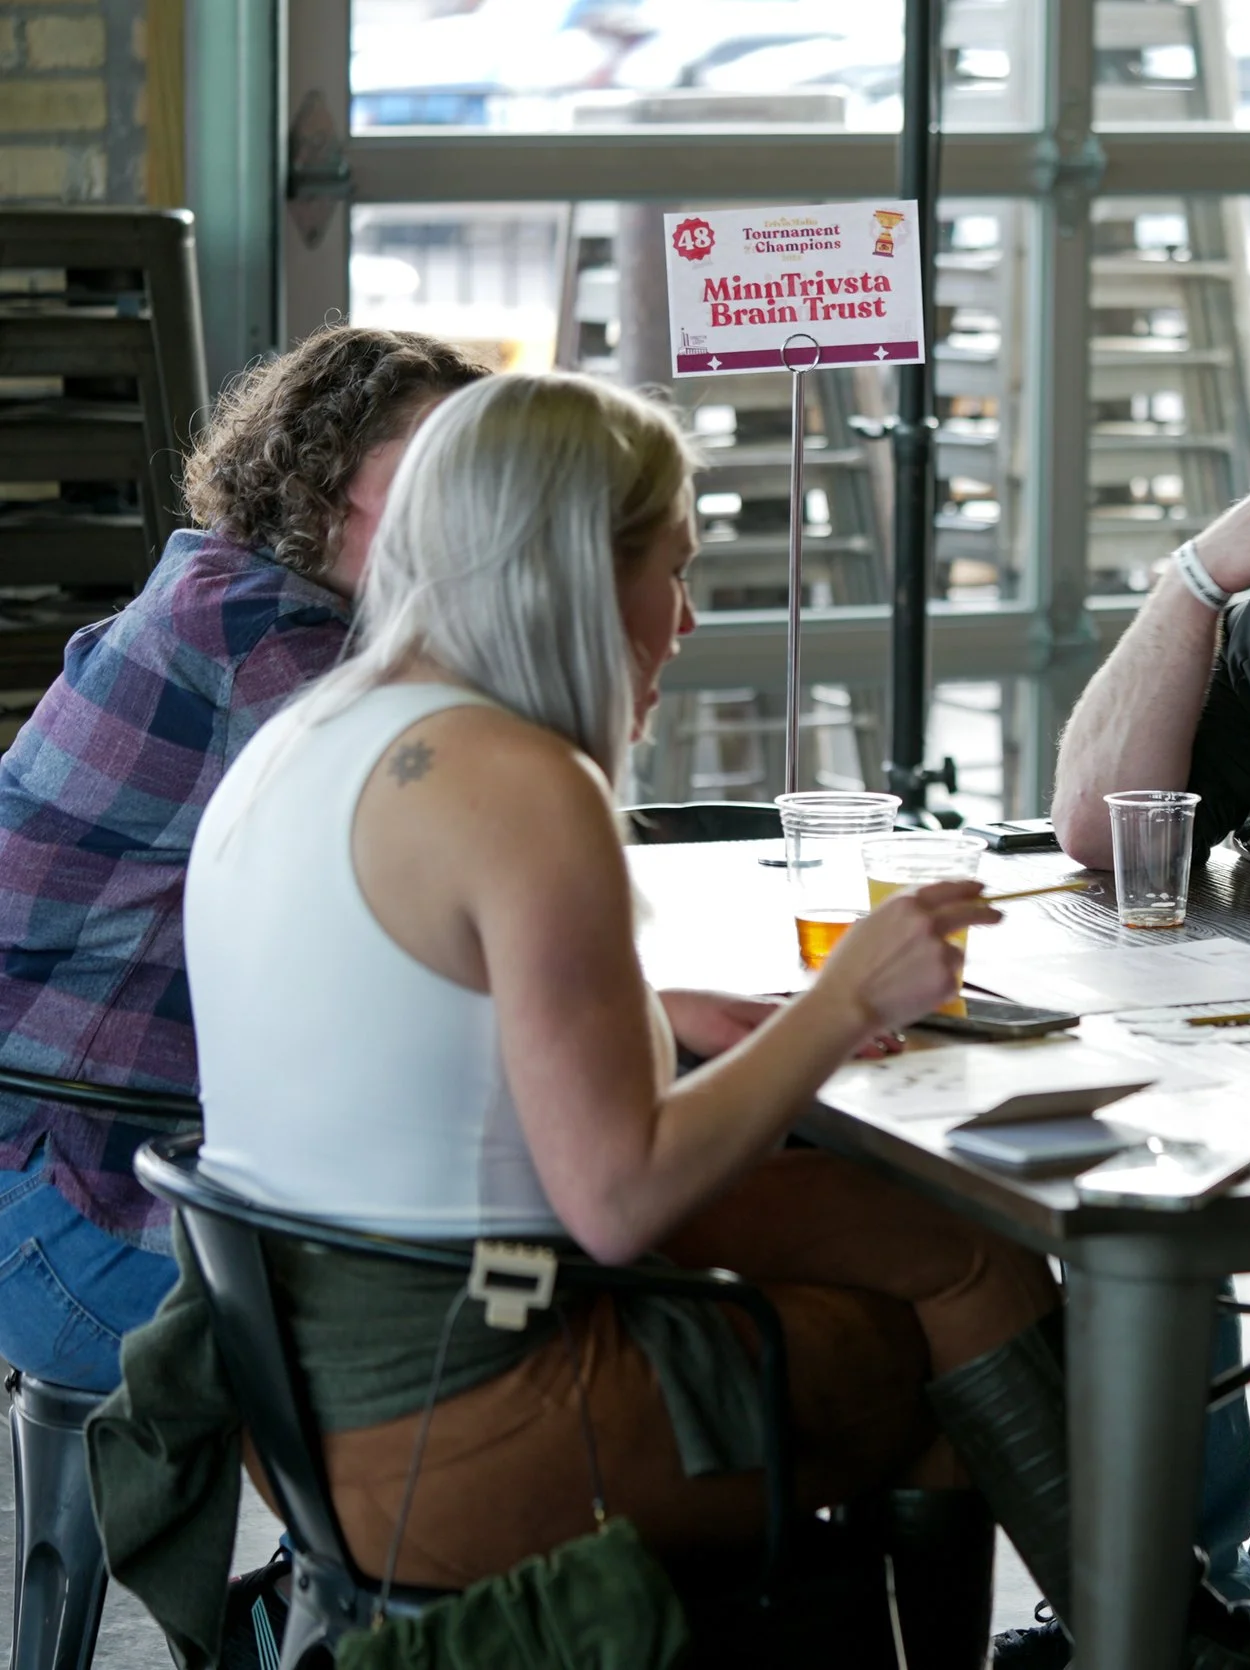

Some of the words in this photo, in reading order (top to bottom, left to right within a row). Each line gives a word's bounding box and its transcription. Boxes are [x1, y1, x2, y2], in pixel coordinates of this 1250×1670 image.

[677, 226, 711, 251] 48
[742, 224, 840, 240] Tournament
[755, 238, 841, 254] Champions
[703, 270, 892, 302] MinnTrivsta
[711, 298, 798, 327] Brain
[803, 297, 887, 320] Trust
